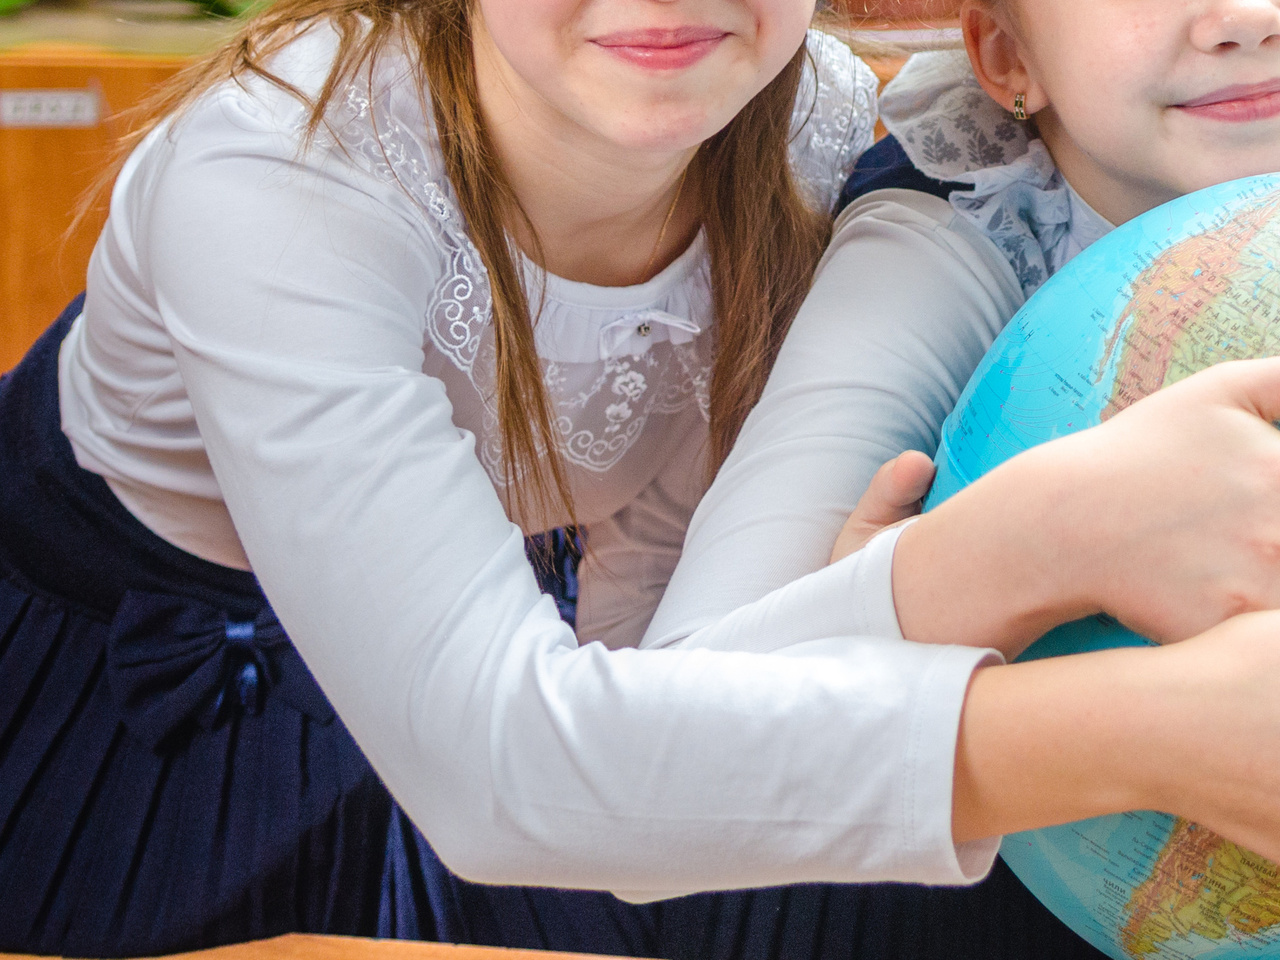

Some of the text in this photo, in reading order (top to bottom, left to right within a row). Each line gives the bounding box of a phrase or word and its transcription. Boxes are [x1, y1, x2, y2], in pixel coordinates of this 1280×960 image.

[1193, 299, 1241, 332] ШТАТЫ
[1171, 309, 1234, 352] АМЕРИКИ
[1240, 857, 1278, 878] ПАРАГВАЙ
[1103, 877, 1126, 895] ЧИЛИ
[1231, 906, 1261, 924] УРУГВАЙ
